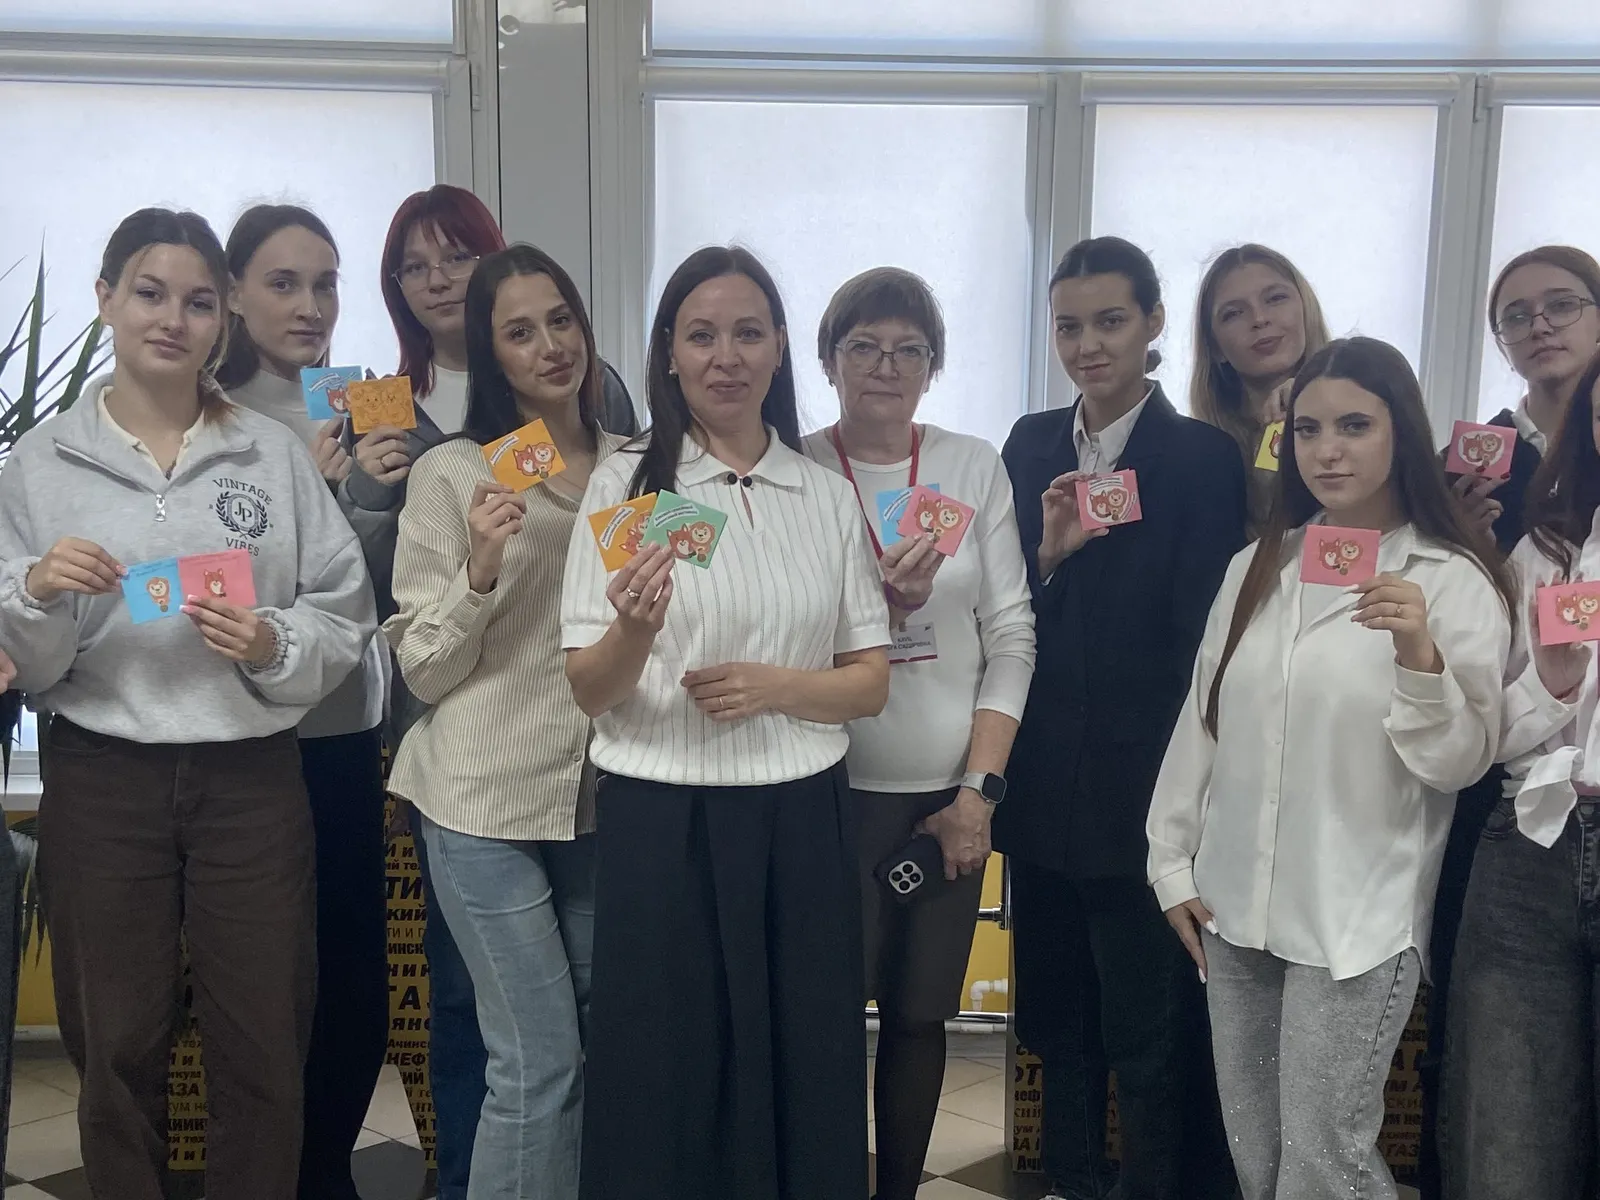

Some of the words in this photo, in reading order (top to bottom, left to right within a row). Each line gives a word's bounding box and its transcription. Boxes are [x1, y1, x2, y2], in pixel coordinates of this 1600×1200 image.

[212, 478, 273, 505] VINTAGE
[234, 502, 253, 522] JP
[403, 862, 420, 870] те
[388, 1039, 430, 1049] Ачинс
[386, 1053, 428, 1066] НЕФ
[401, 1068, 424, 1085] ий
[1385, 1144, 1418, 1157] ГАЗ
